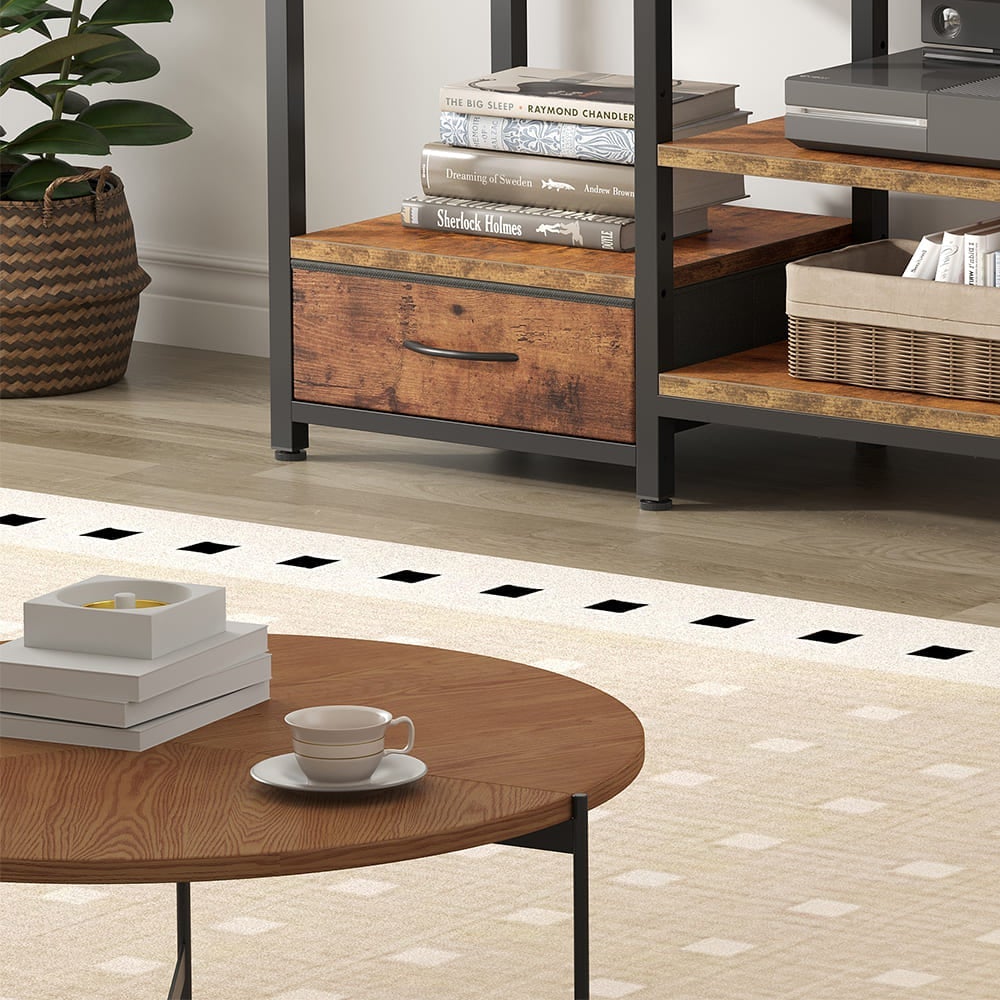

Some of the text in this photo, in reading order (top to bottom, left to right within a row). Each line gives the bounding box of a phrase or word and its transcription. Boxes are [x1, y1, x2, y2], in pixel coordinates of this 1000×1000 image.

[446, 97, 635, 122] THE BIG SLEEP RAYMOND CHANDLER
[446, 168, 635, 197] Dreaming of Sweden Andrew Brown
[437, 208, 482, 232] Sherlock
[485, 214, 522, 237] Holmes
